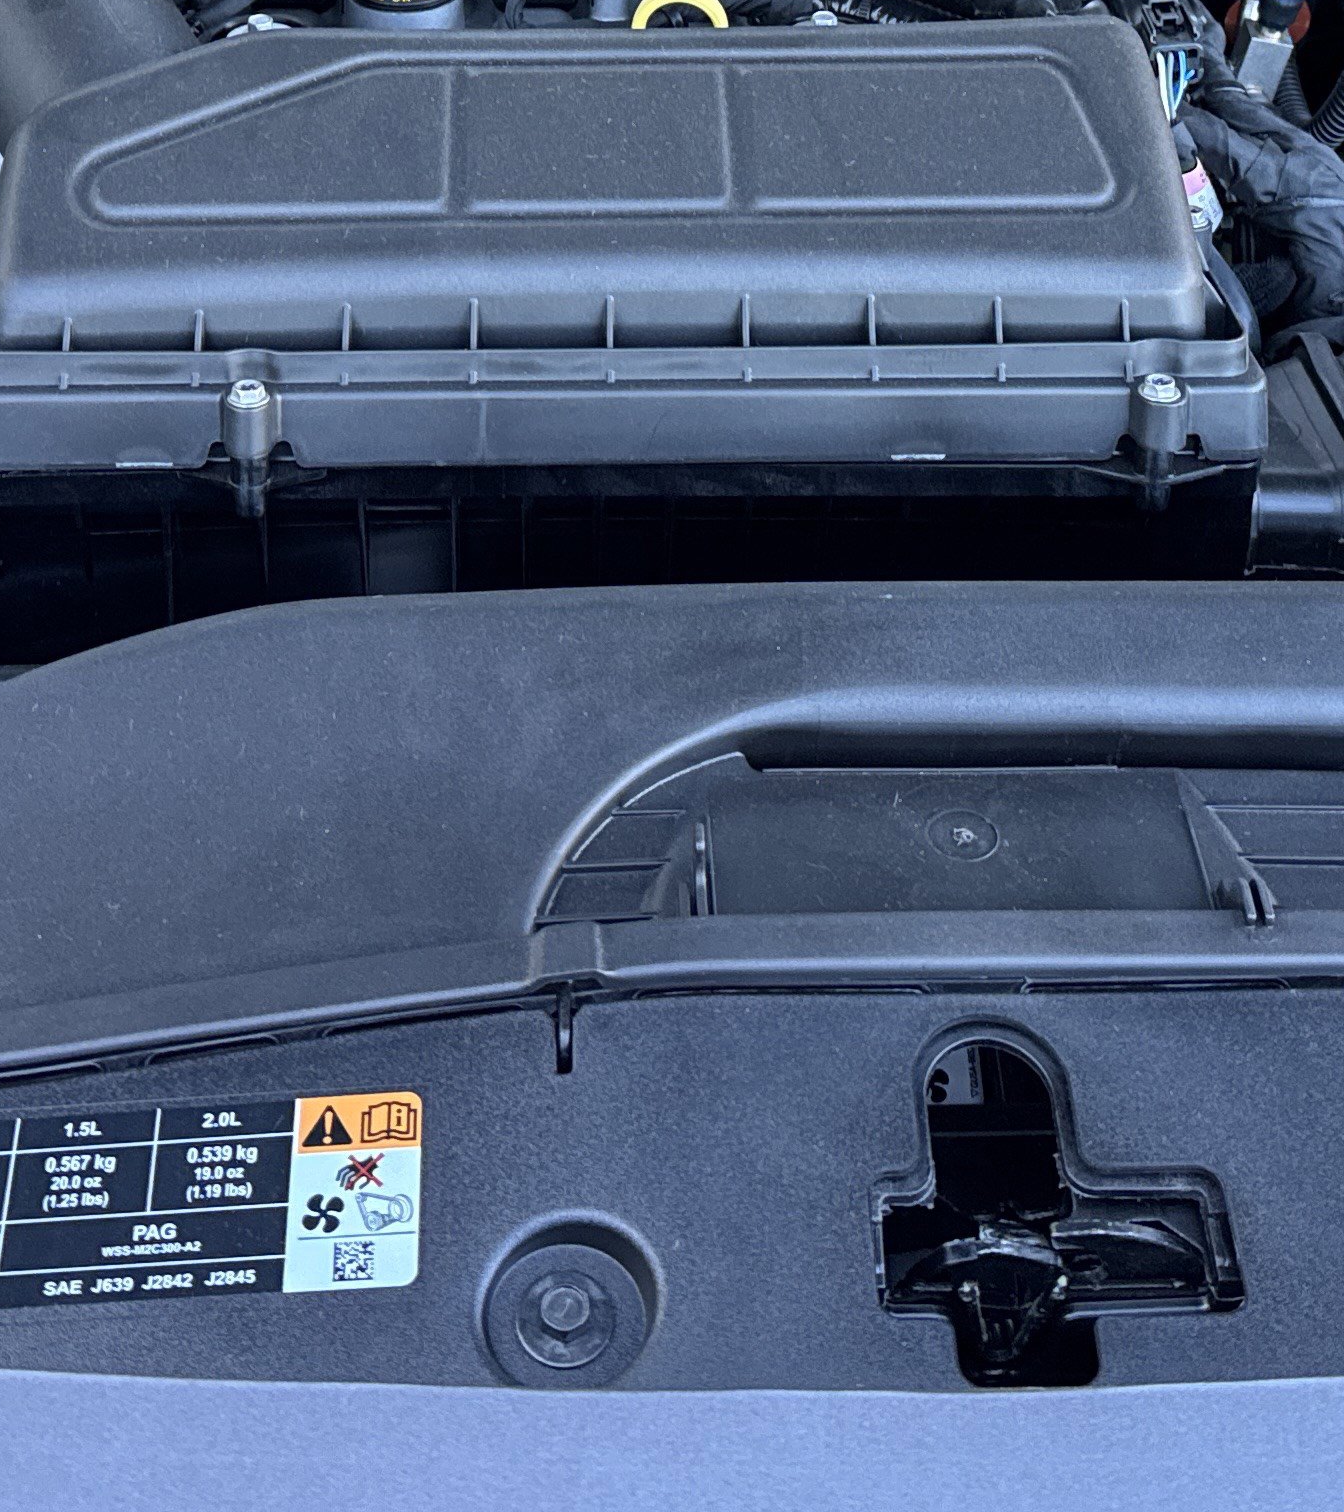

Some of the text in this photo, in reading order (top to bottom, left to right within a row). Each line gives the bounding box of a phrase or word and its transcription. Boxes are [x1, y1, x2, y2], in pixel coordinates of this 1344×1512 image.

[64, 1121, 102, 1138] 1.5L
[202, 1112, 242, 1128] 2.0L
[45, 1154, 117, 1173] 0.567 kg
[186, 1144, 258, 1164] 0.539 kg
[194, 1166, 245, 1181] 19.0 oz
[50, 1176, 102, 1191] 20.0 oz
[186, 1182, 253, 1202] (1.19 lbs)
[42, 1191, 110, 1212] (1.25 lbs)
[132, 1223, 177, 1242] PAG
[43, 1269, 256, 1296] SAE J639 J2842 J2845
